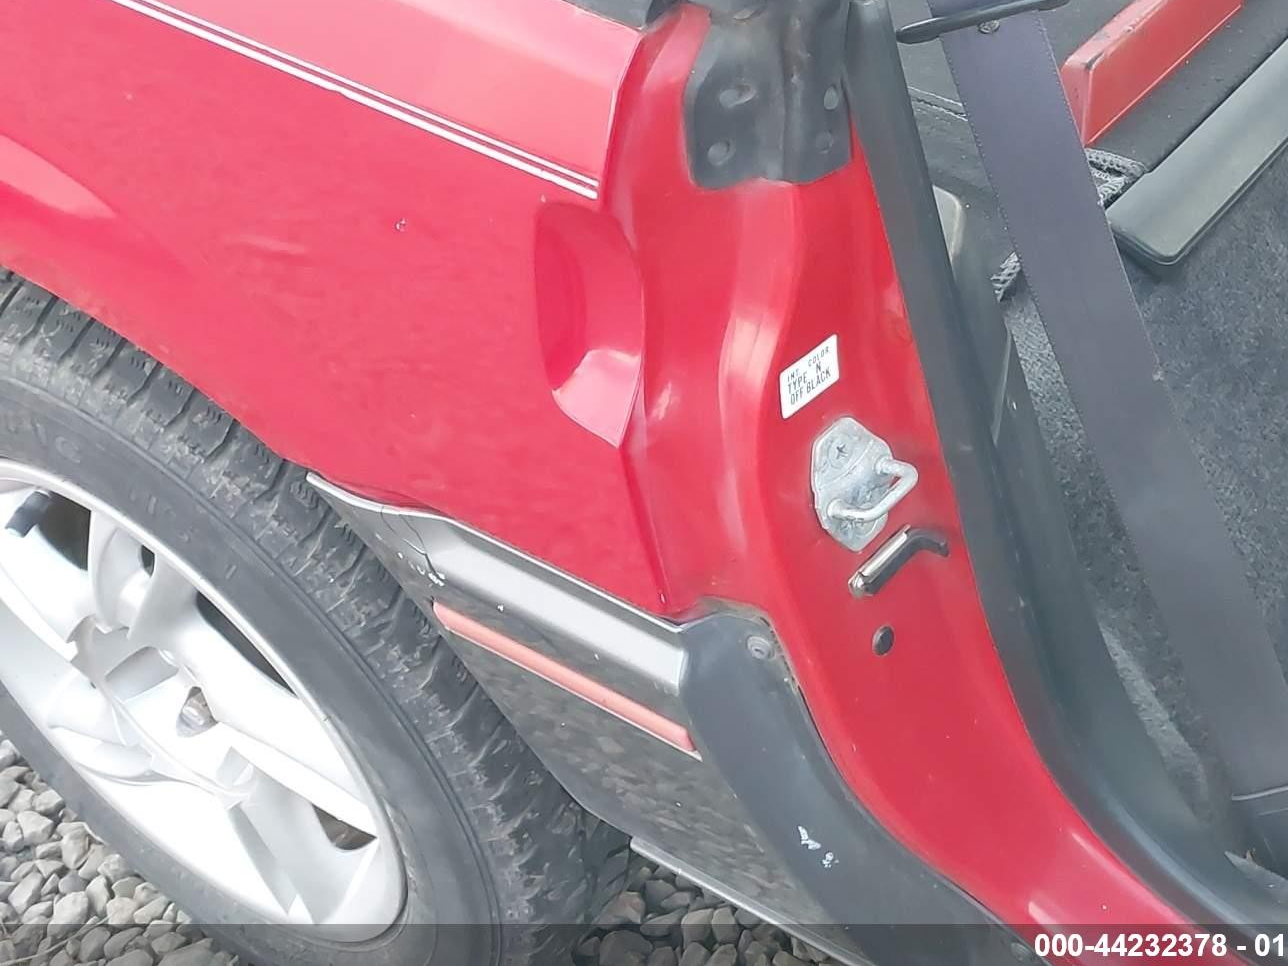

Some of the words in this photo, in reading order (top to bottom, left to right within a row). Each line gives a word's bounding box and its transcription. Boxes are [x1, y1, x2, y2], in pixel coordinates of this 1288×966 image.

[808, 346, 829, 367] COLOR
[787, 371, 807, 394] TYPE
[815, 361, 822, 374] N
[790, 387, 803, 405] OFF
[806, 366, 831, 394] BLACK
